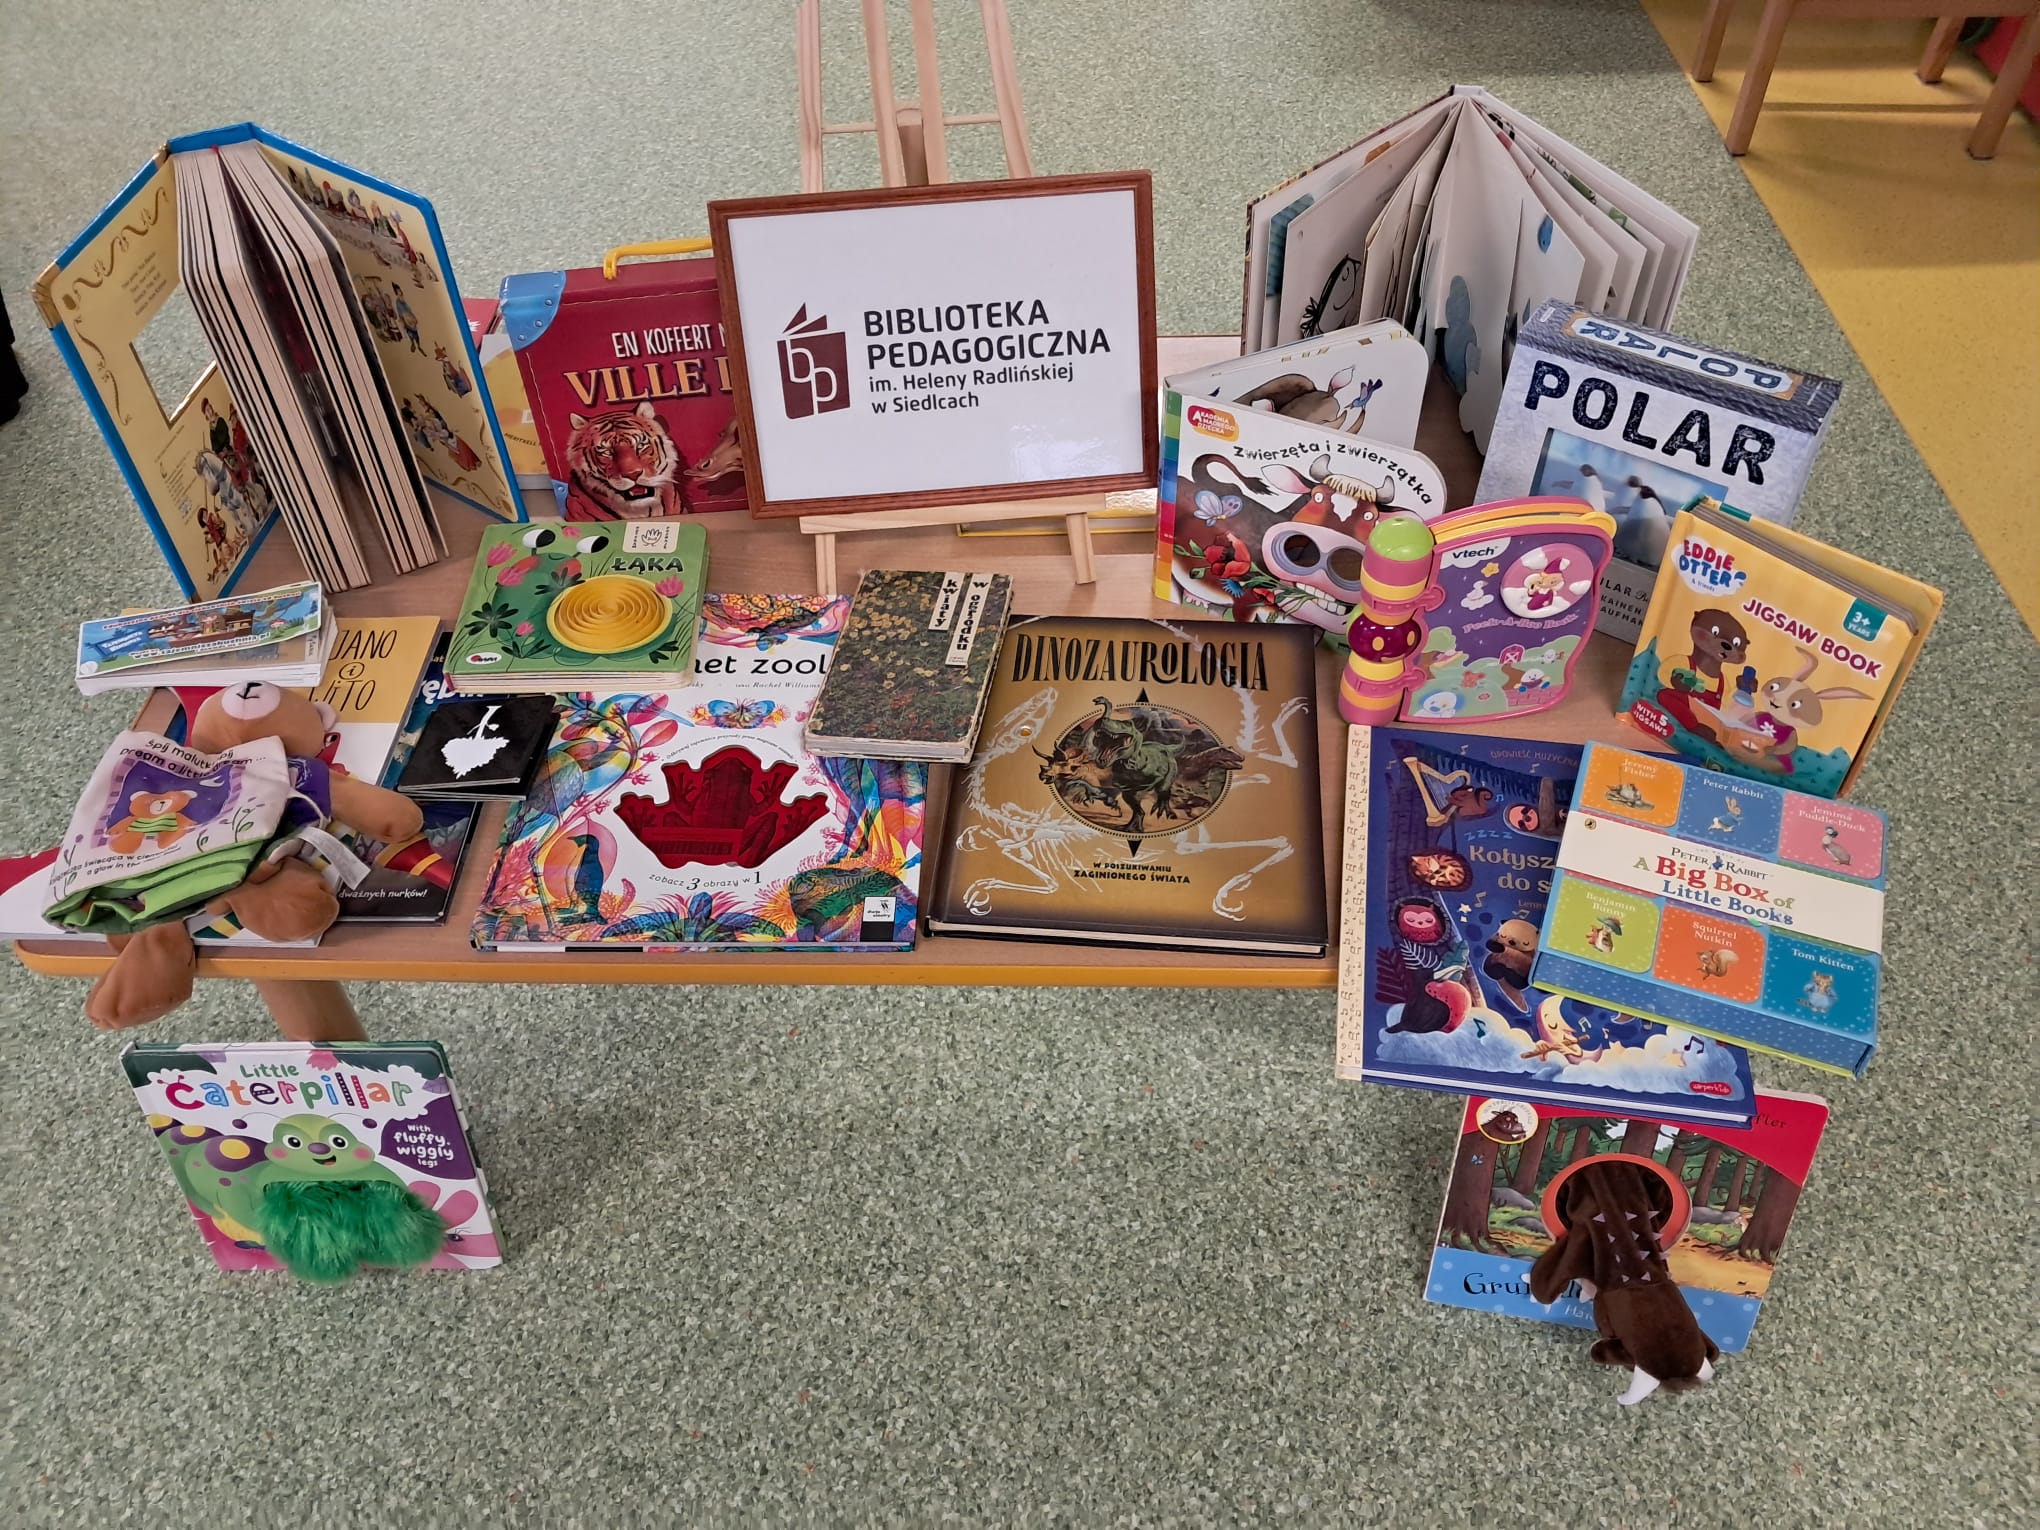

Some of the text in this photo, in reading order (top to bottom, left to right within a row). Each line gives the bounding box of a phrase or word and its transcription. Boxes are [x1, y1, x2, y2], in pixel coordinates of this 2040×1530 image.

[863, 299, 1050, 337] BIBLIOTEKA
[611, 331, 639, 359] EN
[643, 324, 712, 355] KOFFERT
[867, 328, 1111, 370] PEDAGOGICZNA
[1580, 320, 1783, 390] POLAR
[563, 358, 707, 406] VILLE
[869, 362, 1074, 393] im. Heleny Radlińskiej
[872, 391, 980, 414] w Siedlcach
[1524, 360, 1776, 486] POLAR
[1233, 440, 1433, 505] Zwierzęta i zwierzątka
[611, 557, 684, 575] ŁĄKA
[1683, 539, 1736, 572] EDDIE
[1679, 555, 1732, 588] OTTER
[934, 578, 959, 628] kwiaty
[1852, 610, 1872, 629] 3+
[1743, 599, 1883, 679] JIGSAW BOOK
[1011, 633, 1269, 691] DINOZAUROLOGIA
[1659, 714, 1668, 727] 5
[1703, 778, 1764, 800] Peter Rabbit
[1812, 804, 1853, 822] Jemima
[1469, 845, 1556, 871] Kołysz
[648, 870, 762, 891] zobacz 3 obrazy w 1
[1073, 869, 1147, 882] ZAGINIONEGO
[1497, 872, 1552, 894] do s
[1633, 856, 1650, 872] A
[1656, 855, 1708, 888] Big
[1714, 871, 1770, 902] Box
[1773, 897, 1795, 910] of
[338, 888, 428, 901] dważnych nurków!
[1662, 879, 1794, 926] Little Books
[1692, 920, 1738, 940] Squirrel
[1791, 947, 1856, 972] Tom Kitten
[239, 1063, 300, 1079] Little
[407, 1124, 431, 1134] With
[397, 1144, 454, 1162] wiggly
[418, 1158, 438, 1169] legs
